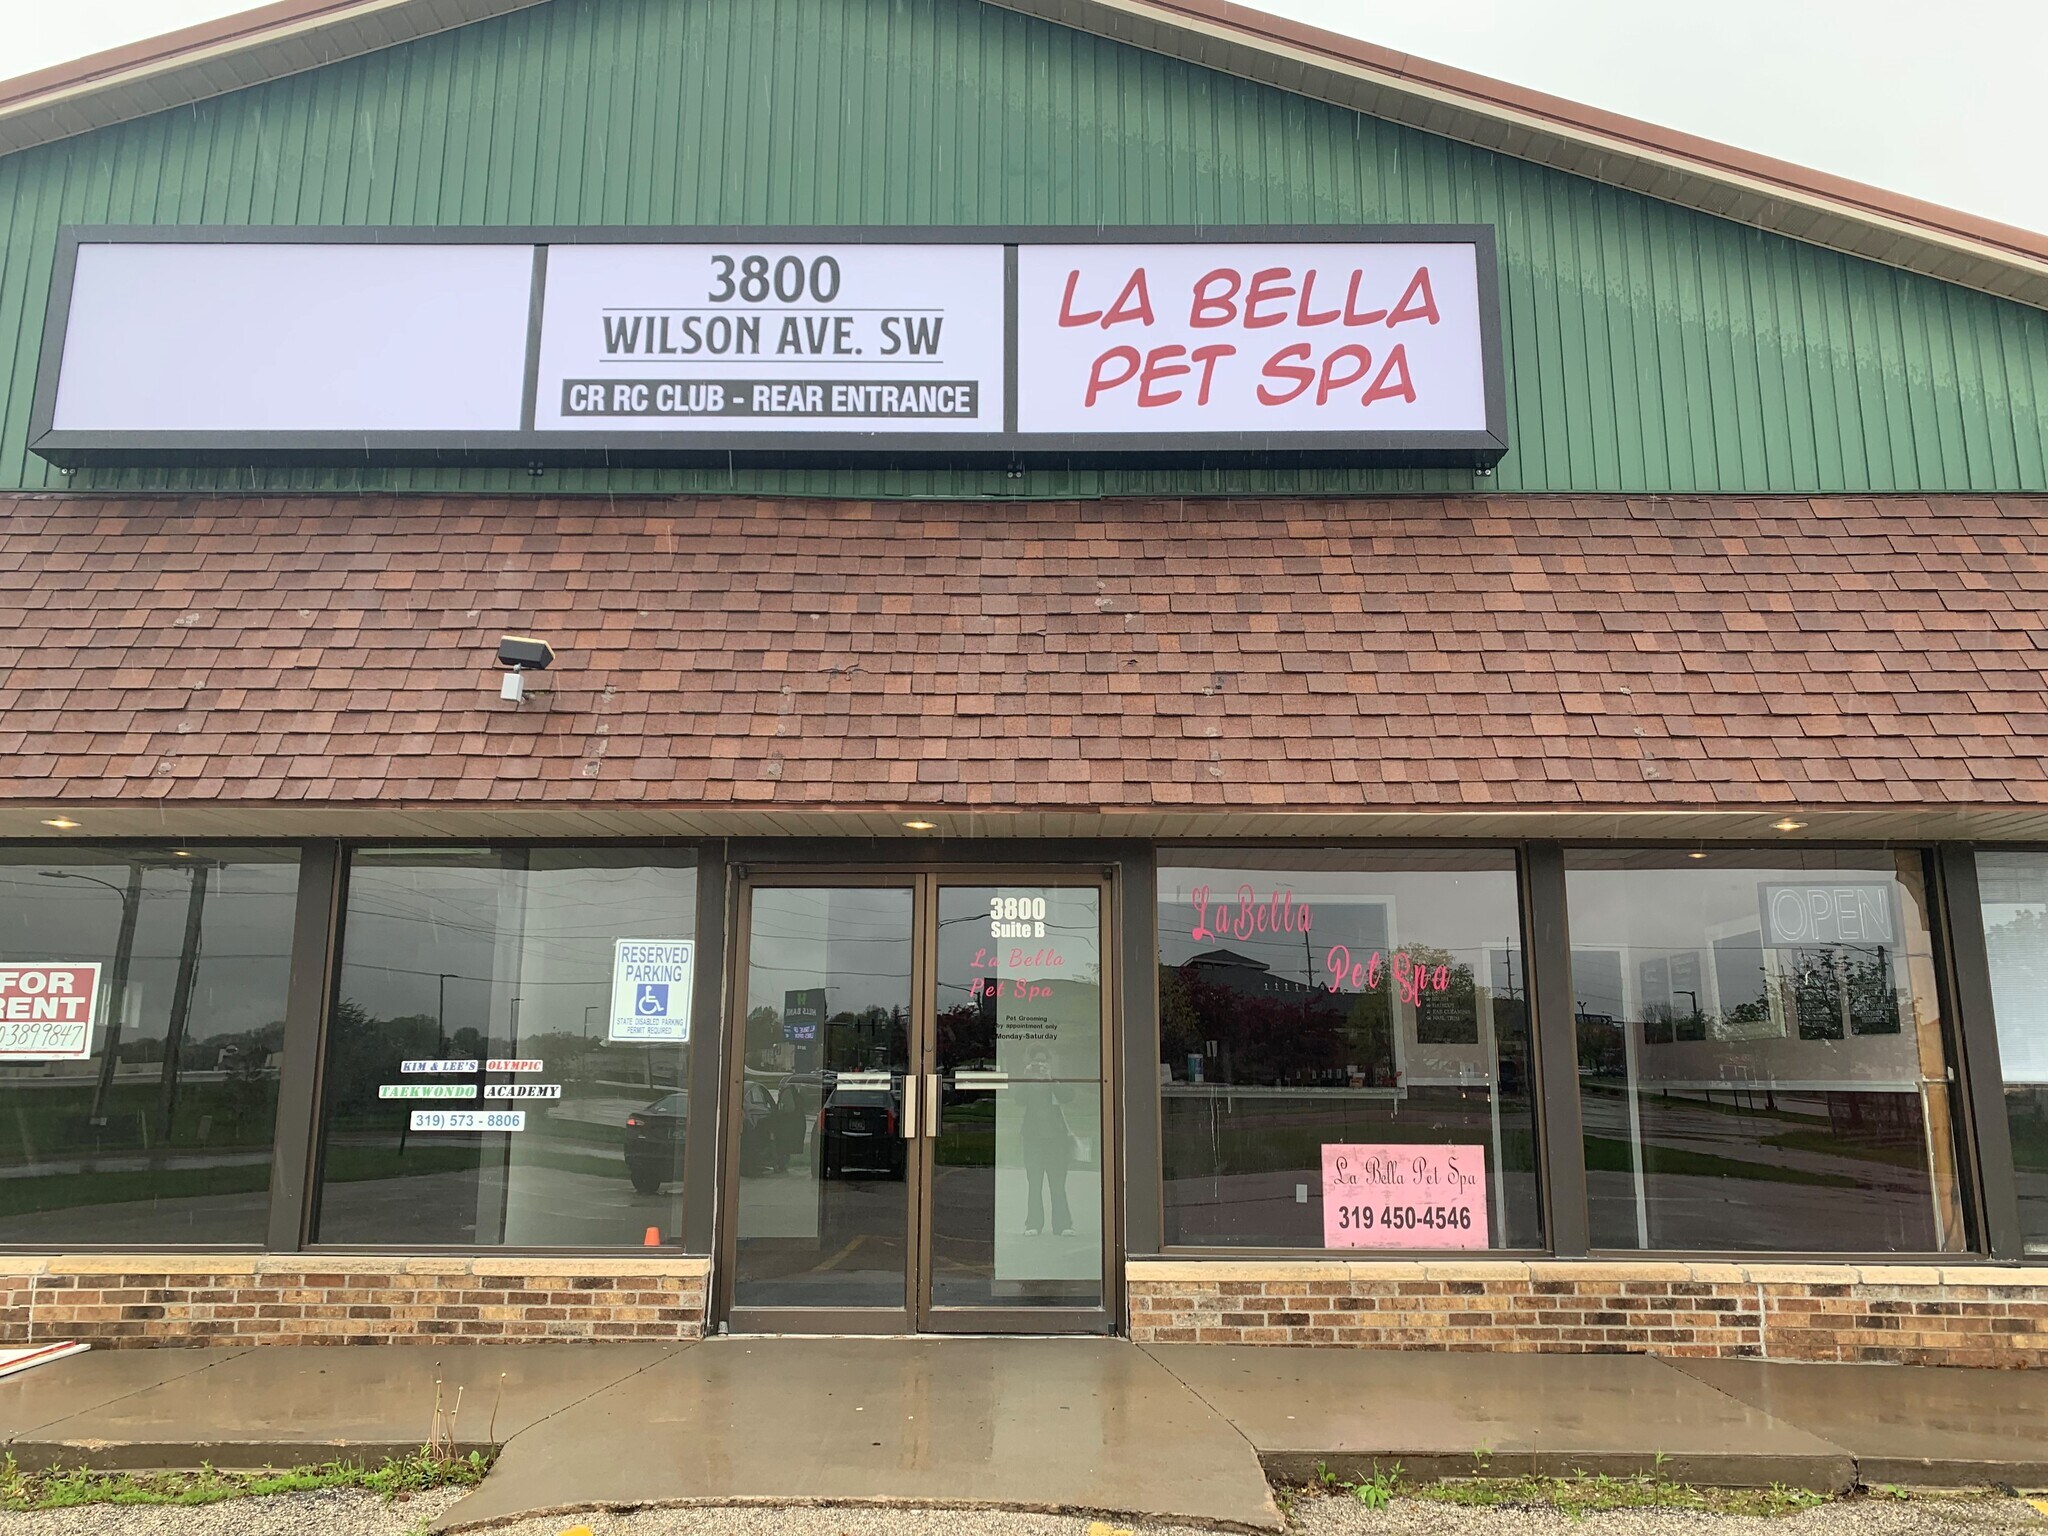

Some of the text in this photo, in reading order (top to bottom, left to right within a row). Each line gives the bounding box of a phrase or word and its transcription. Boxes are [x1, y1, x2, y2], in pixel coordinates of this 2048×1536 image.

[708, 255, 840, 303] 3800
[1058, 267, 1440, 330] LA BELLA
[602, 316, 944, 355] WILSON AVE. SW
[1085, 343, 1416, 407] PET SPA
[569, 384, 604, 412] CR
[613, 384, 648, 412] RC
[656, 384, 724, 412] CLUB
[752, 385, 823, 413] REAR
[833, 385, 970, 413] ENTRANCE
[990, 897, 1046, 920] 3800
[1772, 889, 1891, 941] OPEN
[991, 921, 1045, 938] Suite B
[621, 947, 689, 963] RESERVED
[970, 948, 1065, 968] La Bella
[0, 972, 75, 994] FOR
[625, 965, 682, 982] PARKING
[1327, 945, 1451, 1008] Pet Spa
[969, 977, 1053, 1002] Pet Spa
[0, 996, 86, 1019] ENT
[1018, 1015, 1047, 1023] Grooming
[617, 1017, 633, 1025] STATE
[661, 1018, 684, 1026] PARKING
[996, 1033, 1058, 1041] Monday-Saturday
[402, 1060, 542, 1072] KIM & LEE'S OLYMPIC
[381, 1086, 560, 1097] TAEKWONDO ACADEMY
[416, 1115, 445, 1129] 319)
[450, 1115, 474, 1127] 573
[487, 1115, 520, 1127] 8806
[1333, 1156, 1478, 1195] La Bella Pet Spa
[1339, 1206, 1471, 1230] 319 450-4546
